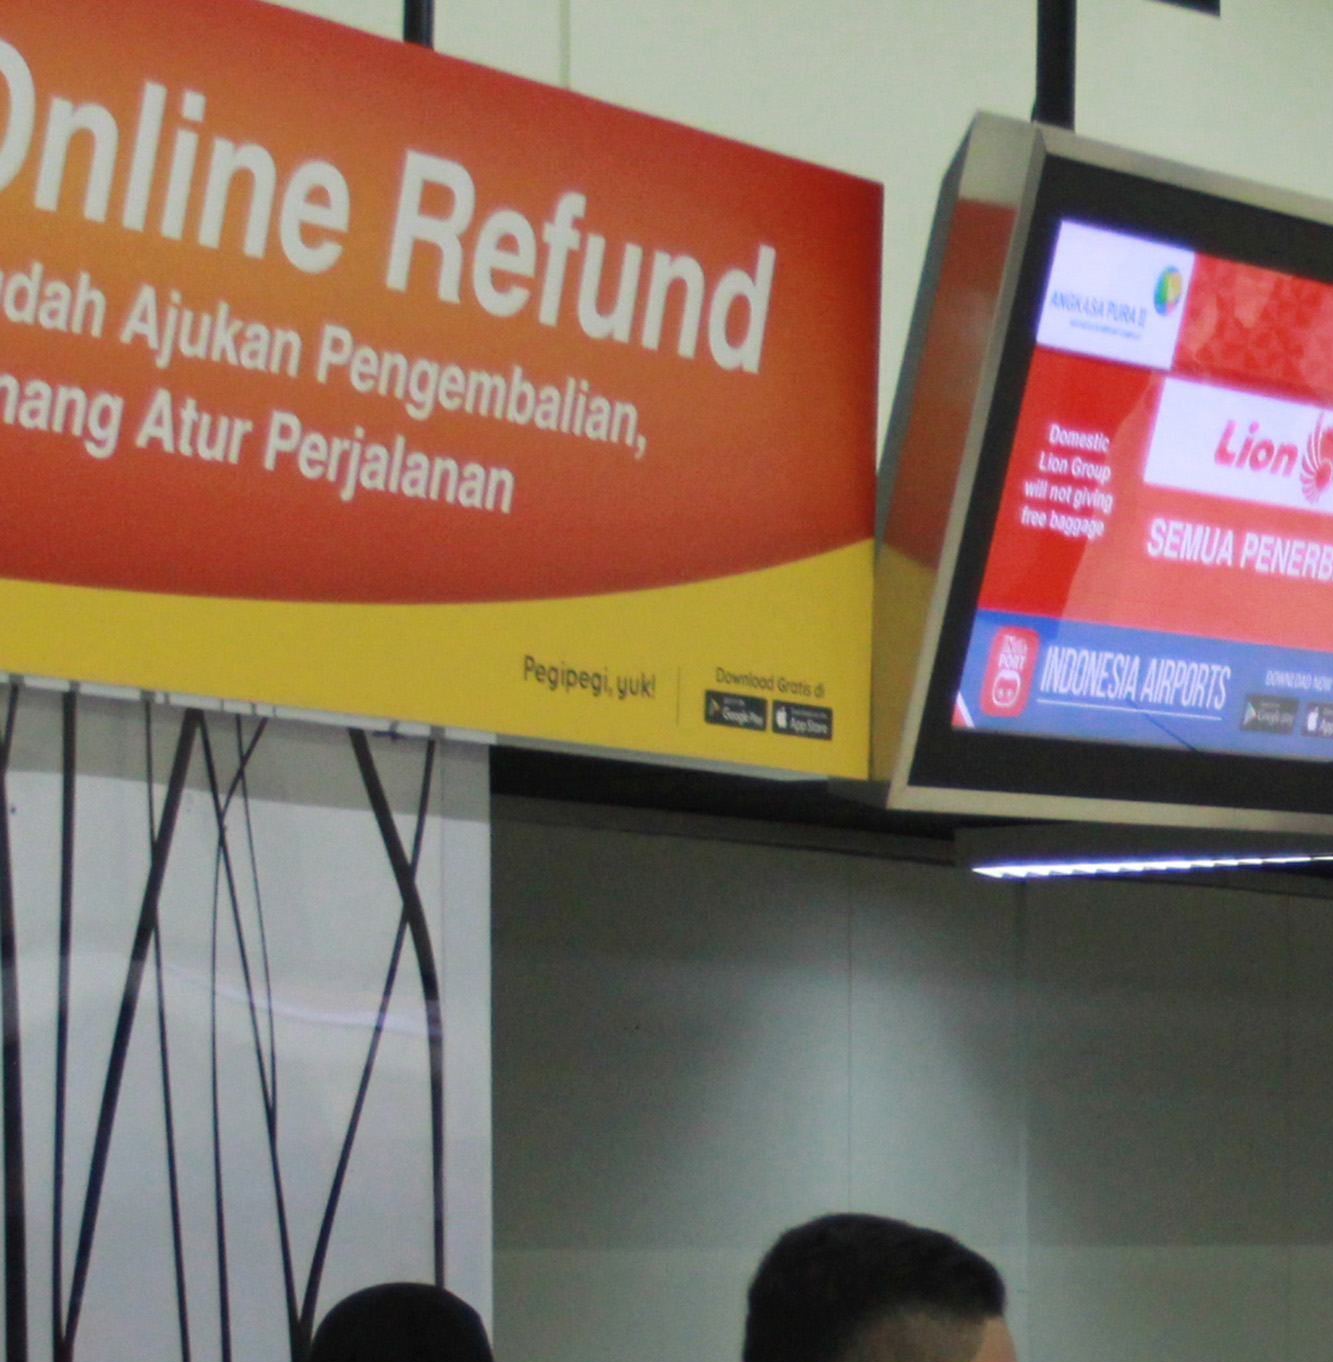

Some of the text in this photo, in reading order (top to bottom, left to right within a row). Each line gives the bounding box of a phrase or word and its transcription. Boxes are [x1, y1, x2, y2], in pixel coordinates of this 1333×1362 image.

[386, 149, 777, 374] Refund
[1106, 300, 1136, 325] PURA
[121, 285, 303, 377] Ajukan
[316, 325, 648, 461] Pengembalian,
[136, 388, 252, 466] Atur
[264, 413, 516, 514] Perjalanan
[1049, 423, 1110, 452] Domestic
[1213, 418, 1298, 480] Lion
[1039, 450, 1112, 485] Lion Group
[1024, 479, 1114, 515] will not giving
[1021, 505, 1105, 541] free baggage
[1146, 516, 1235, 569] SEMUA
[524, 655, 656, 699] Pegipegi, yuk!
[716, 667, 825, 698] Download Gratis di
[1039, 644, 1232, 711] INDONESIA AIRPORTS
[1264, 669, 1309, 690] DOWNLOAD
[790, 716, 829, 735] App Store
